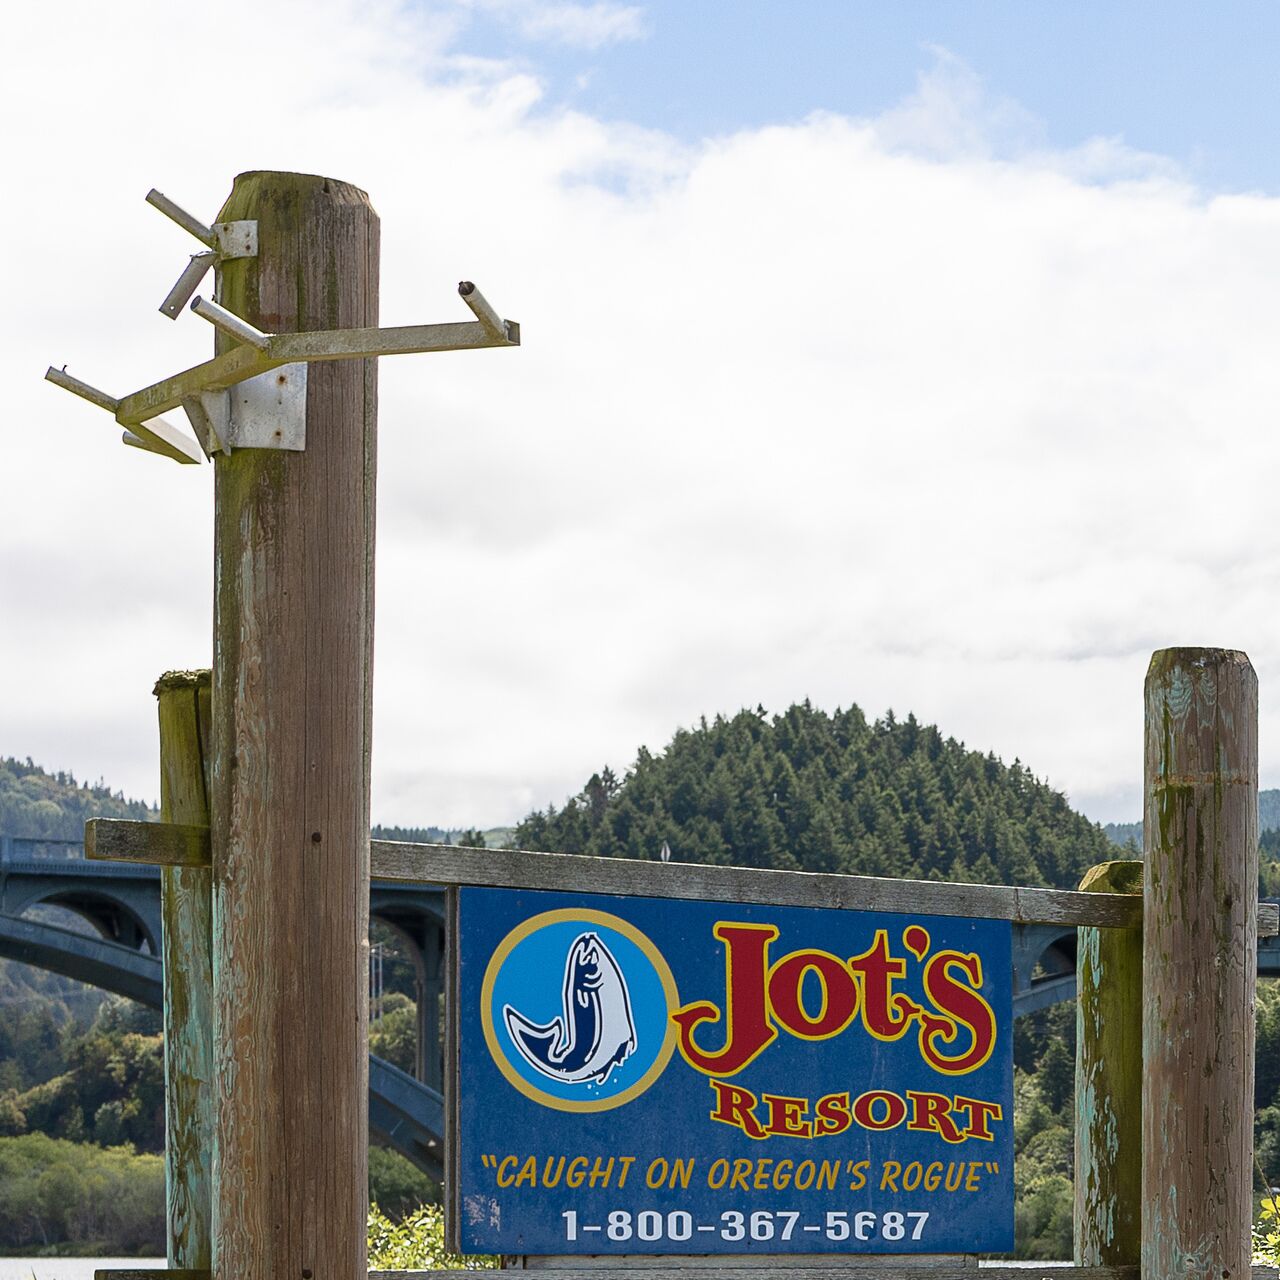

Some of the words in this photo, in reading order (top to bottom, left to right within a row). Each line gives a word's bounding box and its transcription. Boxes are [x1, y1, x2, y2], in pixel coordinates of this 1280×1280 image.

[709, 1079, 1003, 1144] RESORT
[481, 1154, 636, 1188] "CAUGHT
[646, 1157, 695, 1189] ON
[707, 1158, 870, 1191] OREGON'S
[880, 1160, 999, 1192] ROGUE"
[562, 1210, 930, 1242] 1-800-367-5687
